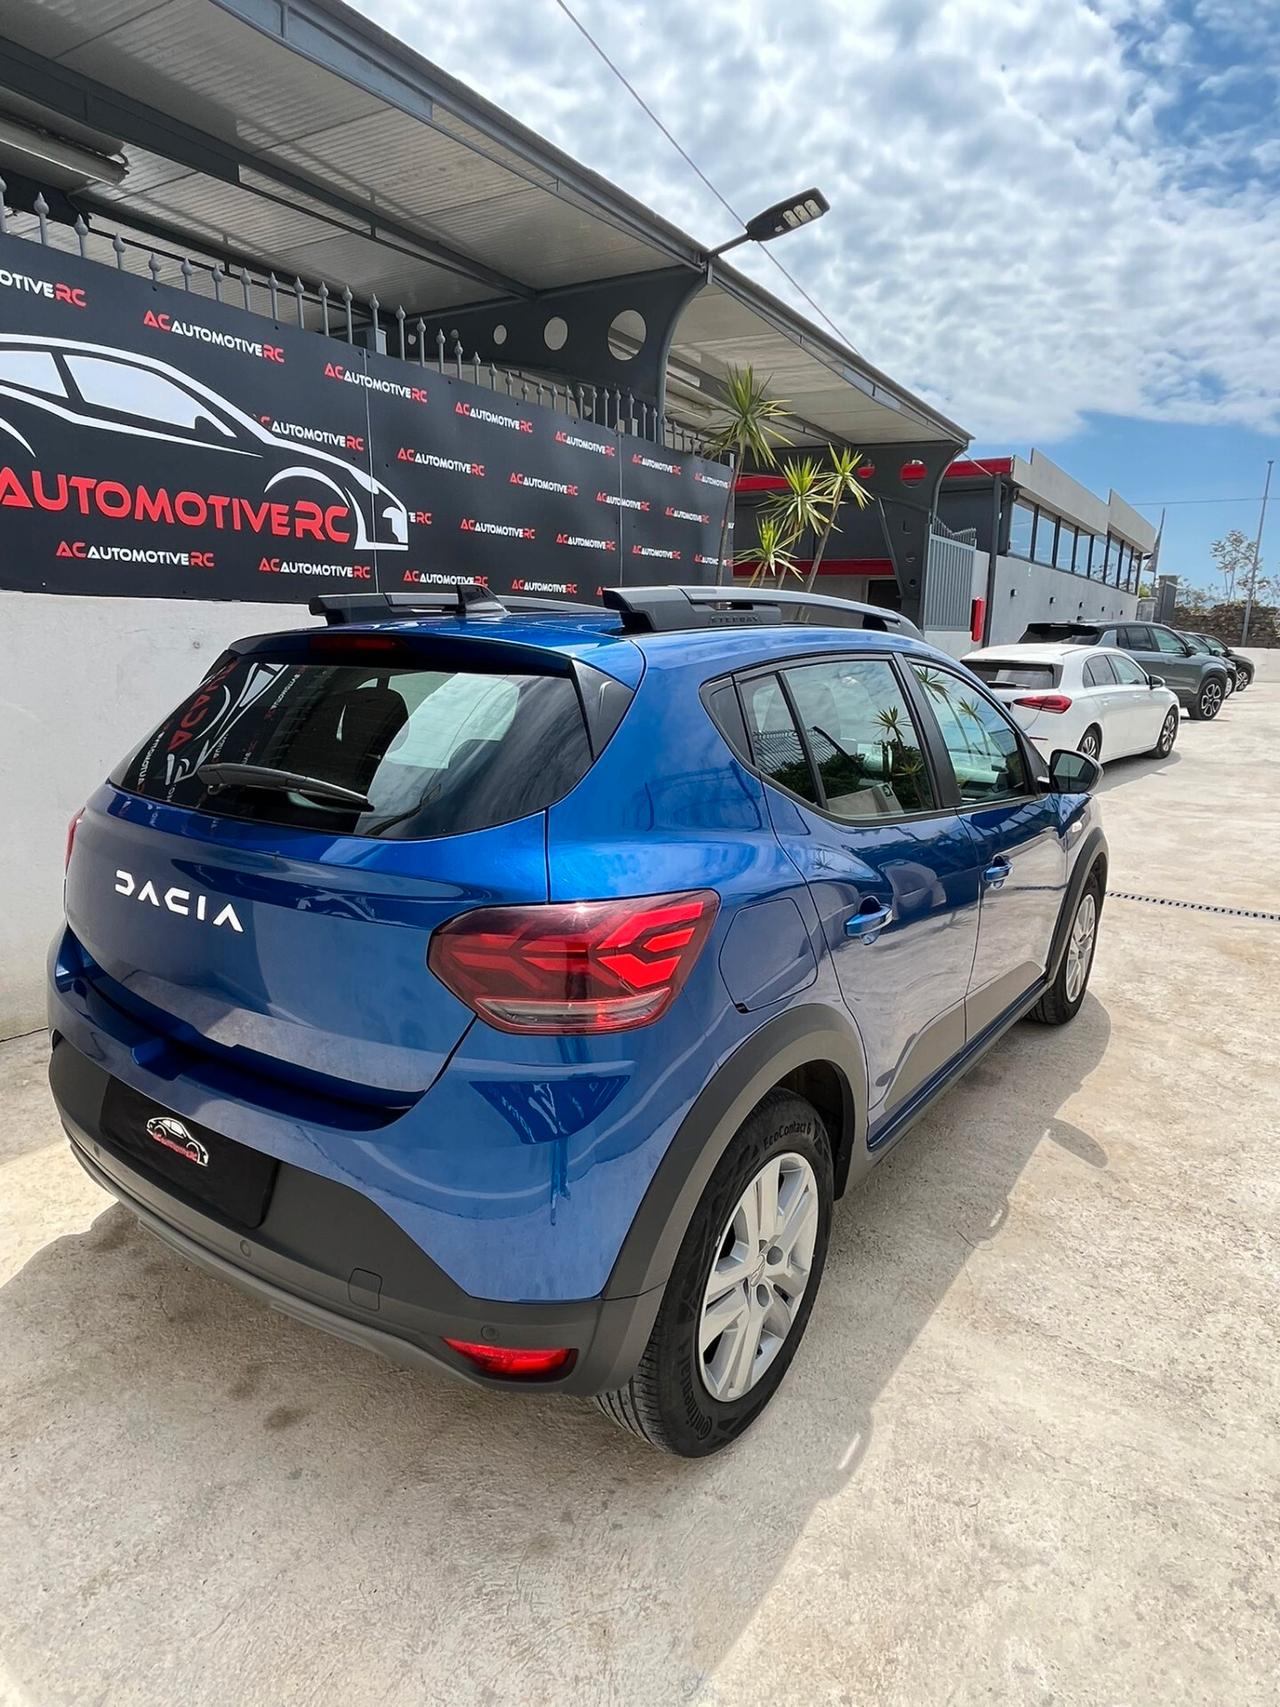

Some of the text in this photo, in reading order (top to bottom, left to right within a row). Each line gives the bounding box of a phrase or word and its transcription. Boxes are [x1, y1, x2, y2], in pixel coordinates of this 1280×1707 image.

[143, 310, 285, 364] ACAUTOMOTIVERC
[324, 362, 427, 405] ACAUTOMOTIVERC
[455, 402, 533, 433] ACAUTOMOTIVERC
[555, 430, 615, 457] ACAUTOMOTIVERC
[397, 447, 486, 477] ACAUTOMOTIVERC
[632, 453, 682, 476] ACAUTOMOTIVERC
[509, 472, 579, 496] ACAUTOMOTIVERC
[0, 466, 350, 543] AUTOMOTIVERC
[596, 491, 650, 512] ACAUTOMOTIVERC
[460, 518, 536, 540] ACAUTOMOTIVERC
[56, 541, 215, 567] ACAUTOMOTIVERC
[556, 533, 616, 551] ACAUTOMOTIVERC
[632, 543, 682, 560] ACAUTOMOTIVERC
[259, 558, 371, 580] ACAUTOMOTIVERC
[404, 570, 488, 587] ACAUTOMOTIVERC
[511, 578, 578, 594] ACAUTOMOTIVERC
[115, 869, 243, 932] DACIA
[763, 1120, 812, 1150] EcoContact 6
